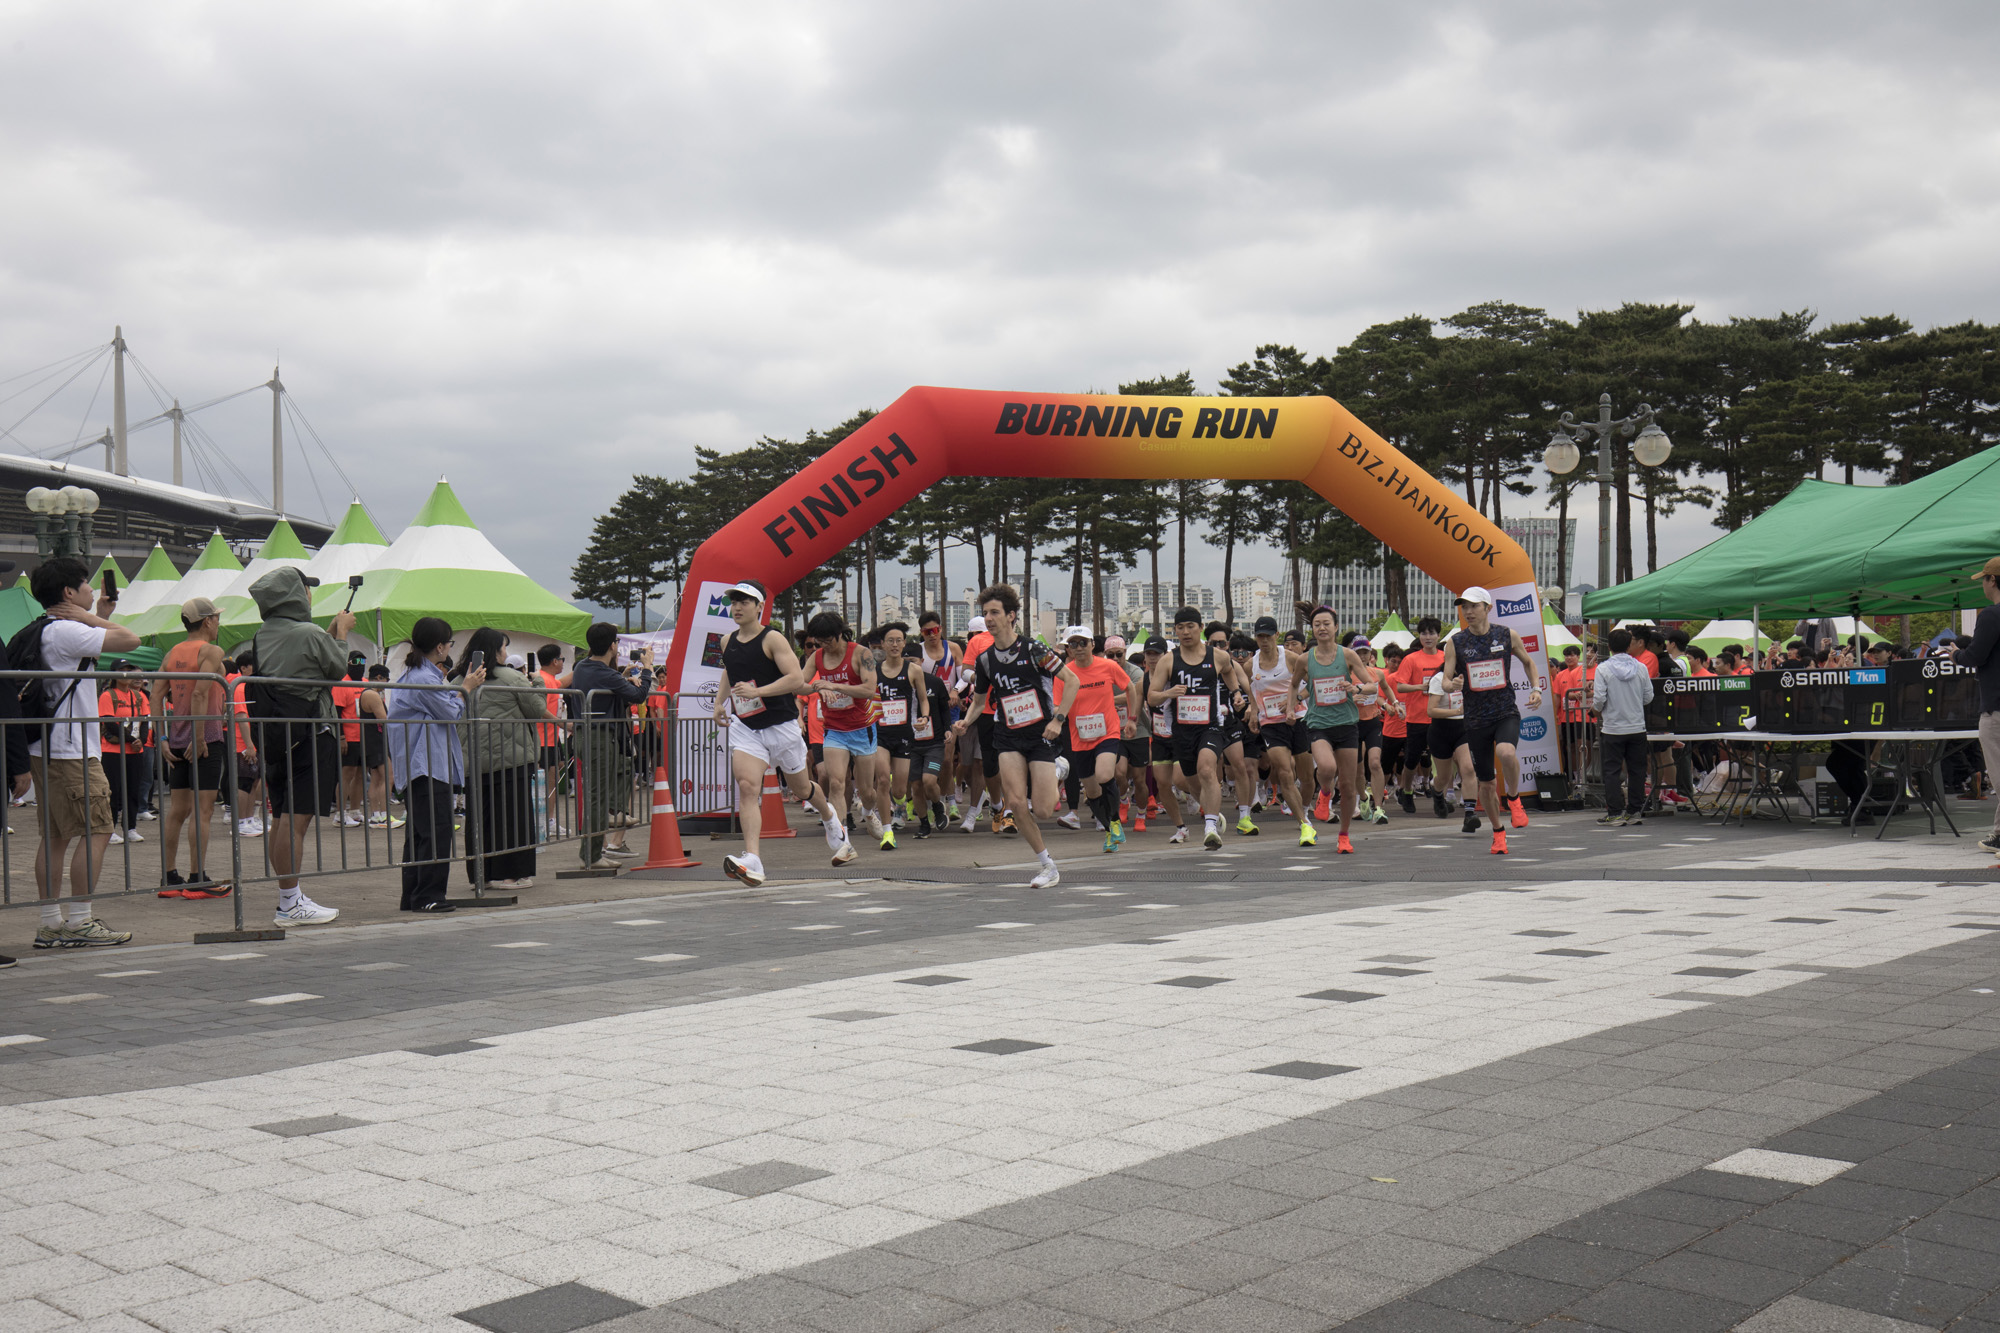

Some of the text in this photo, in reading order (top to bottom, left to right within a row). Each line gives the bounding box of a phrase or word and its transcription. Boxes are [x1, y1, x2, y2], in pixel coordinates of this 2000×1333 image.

[995, 402, 1279, 440] BURNING RUN
[1139, 440, 1177, 452] Casual
[1229, 440, 1270, 452] Festival
[762, 432, 918, 558] FINISH
[1500, 598, 1532, 615] Maeil
[1479, 670, 1500, 679] 2366
[1856, 672, 1879, 682] 7km
[1723, 680, 1746, 689] 10km
[1013, 701, 1035, 714] 1044
[1870, 702, 1884, 725] 0
[1084, 723, 1103, 731] 1314
[1520, 725, 1545, 738] 백산수
[1521, 753, 1548, 765] TOUS
[1532, 763, 1541, 772] les
